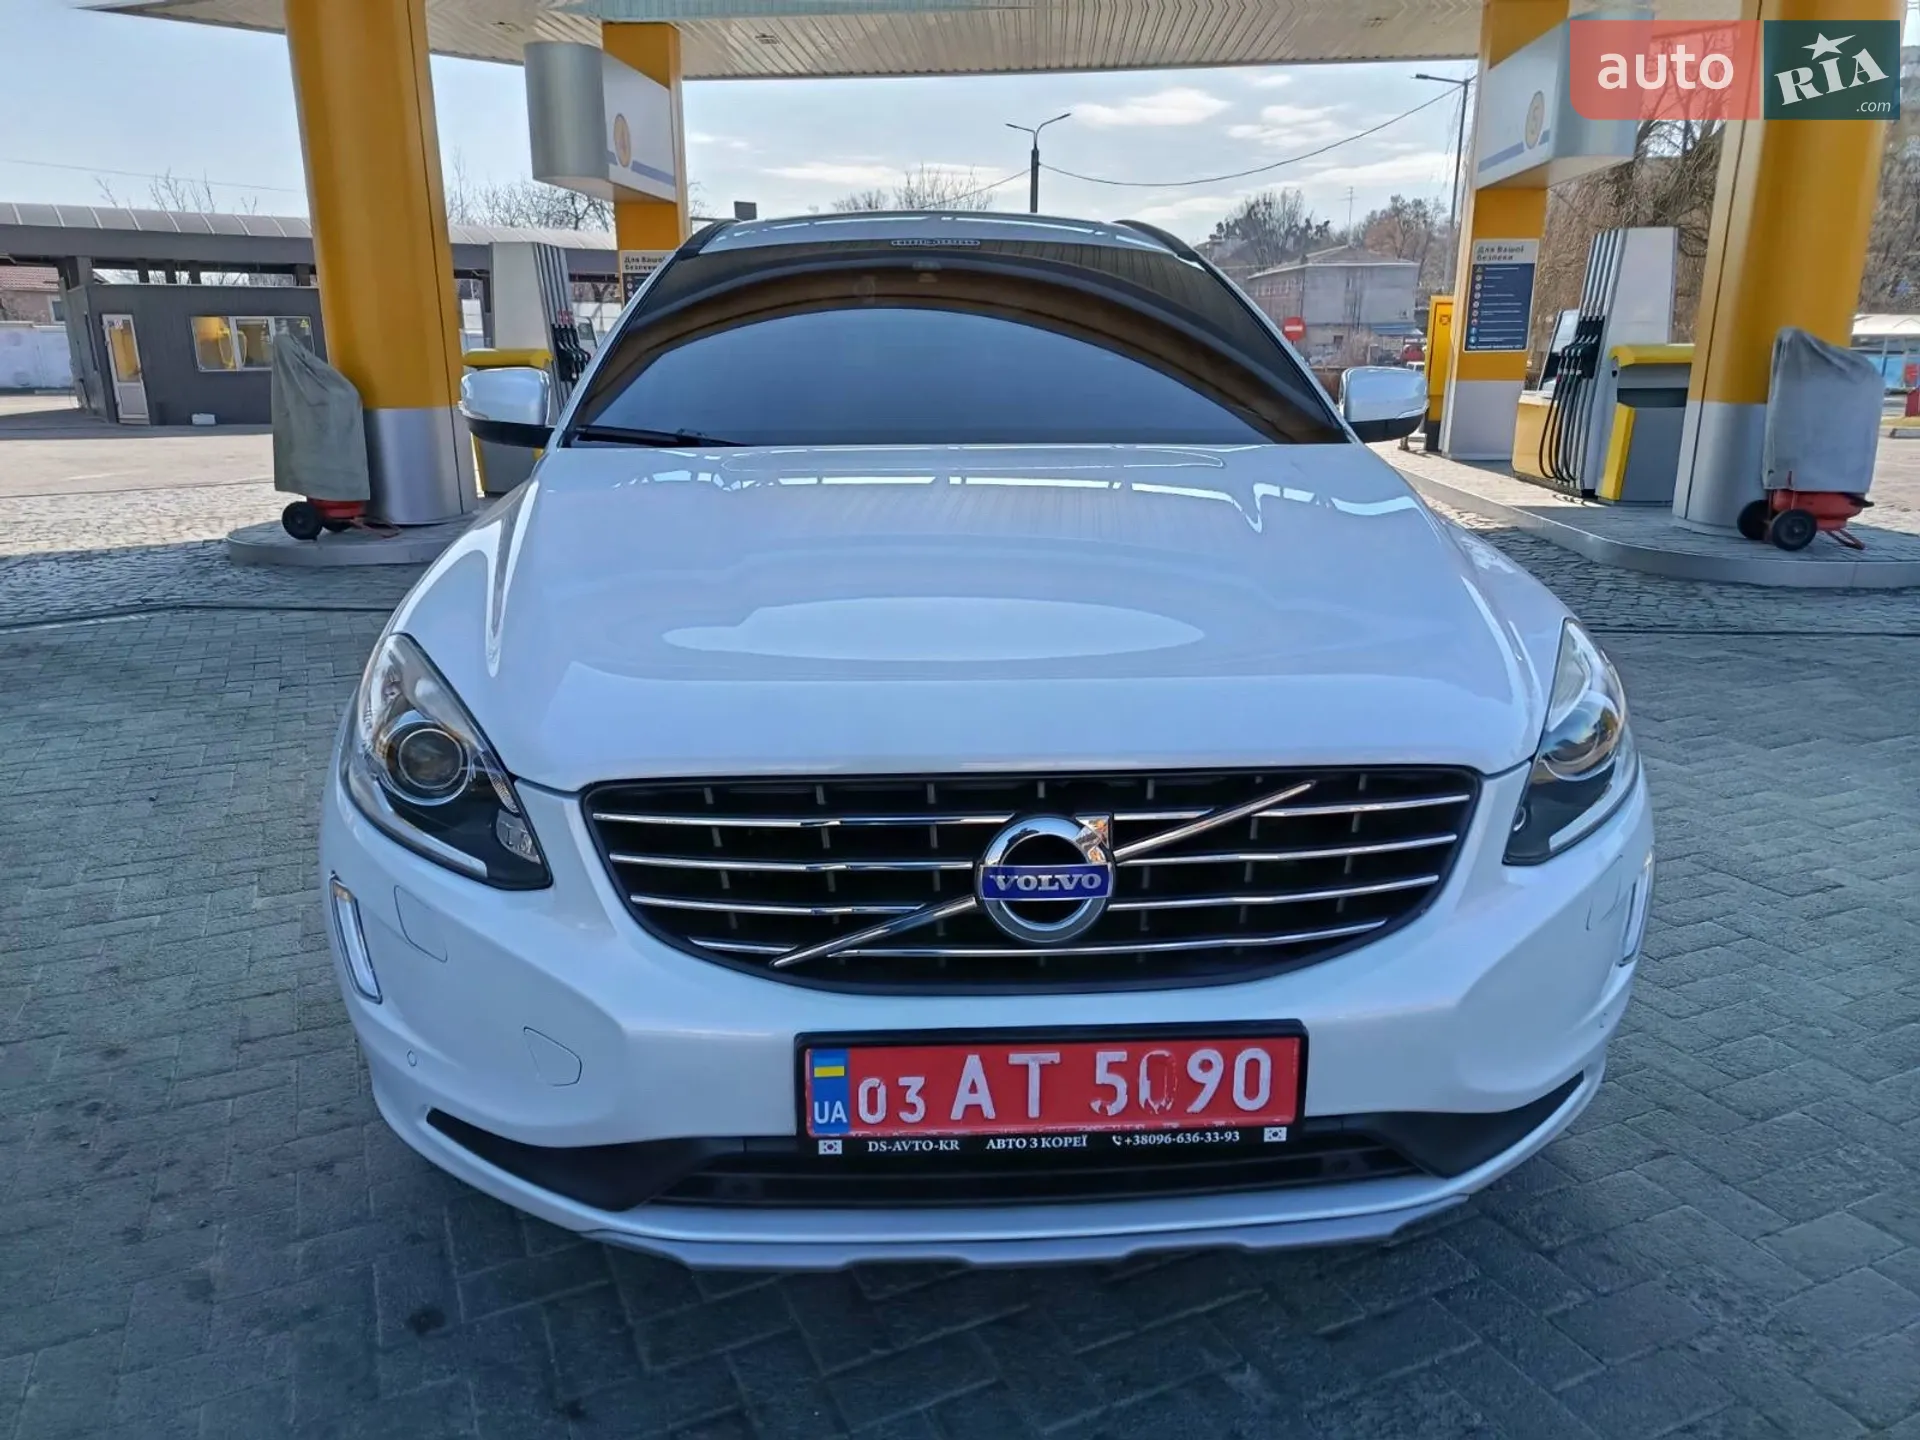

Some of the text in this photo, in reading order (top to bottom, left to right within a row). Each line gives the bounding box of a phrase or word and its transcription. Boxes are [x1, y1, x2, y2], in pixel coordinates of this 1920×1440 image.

[989, 873, 1102, 891] VOLVO
[858, 1076, 926, 1124] 03
[950, 1052, 1061, 1121] AT
[814, 1100, 848, 1124] UA
[867, 1140, 961, 1152] DS-AVTO-KR
[986, 1137, 1027, 1150] АВТО
